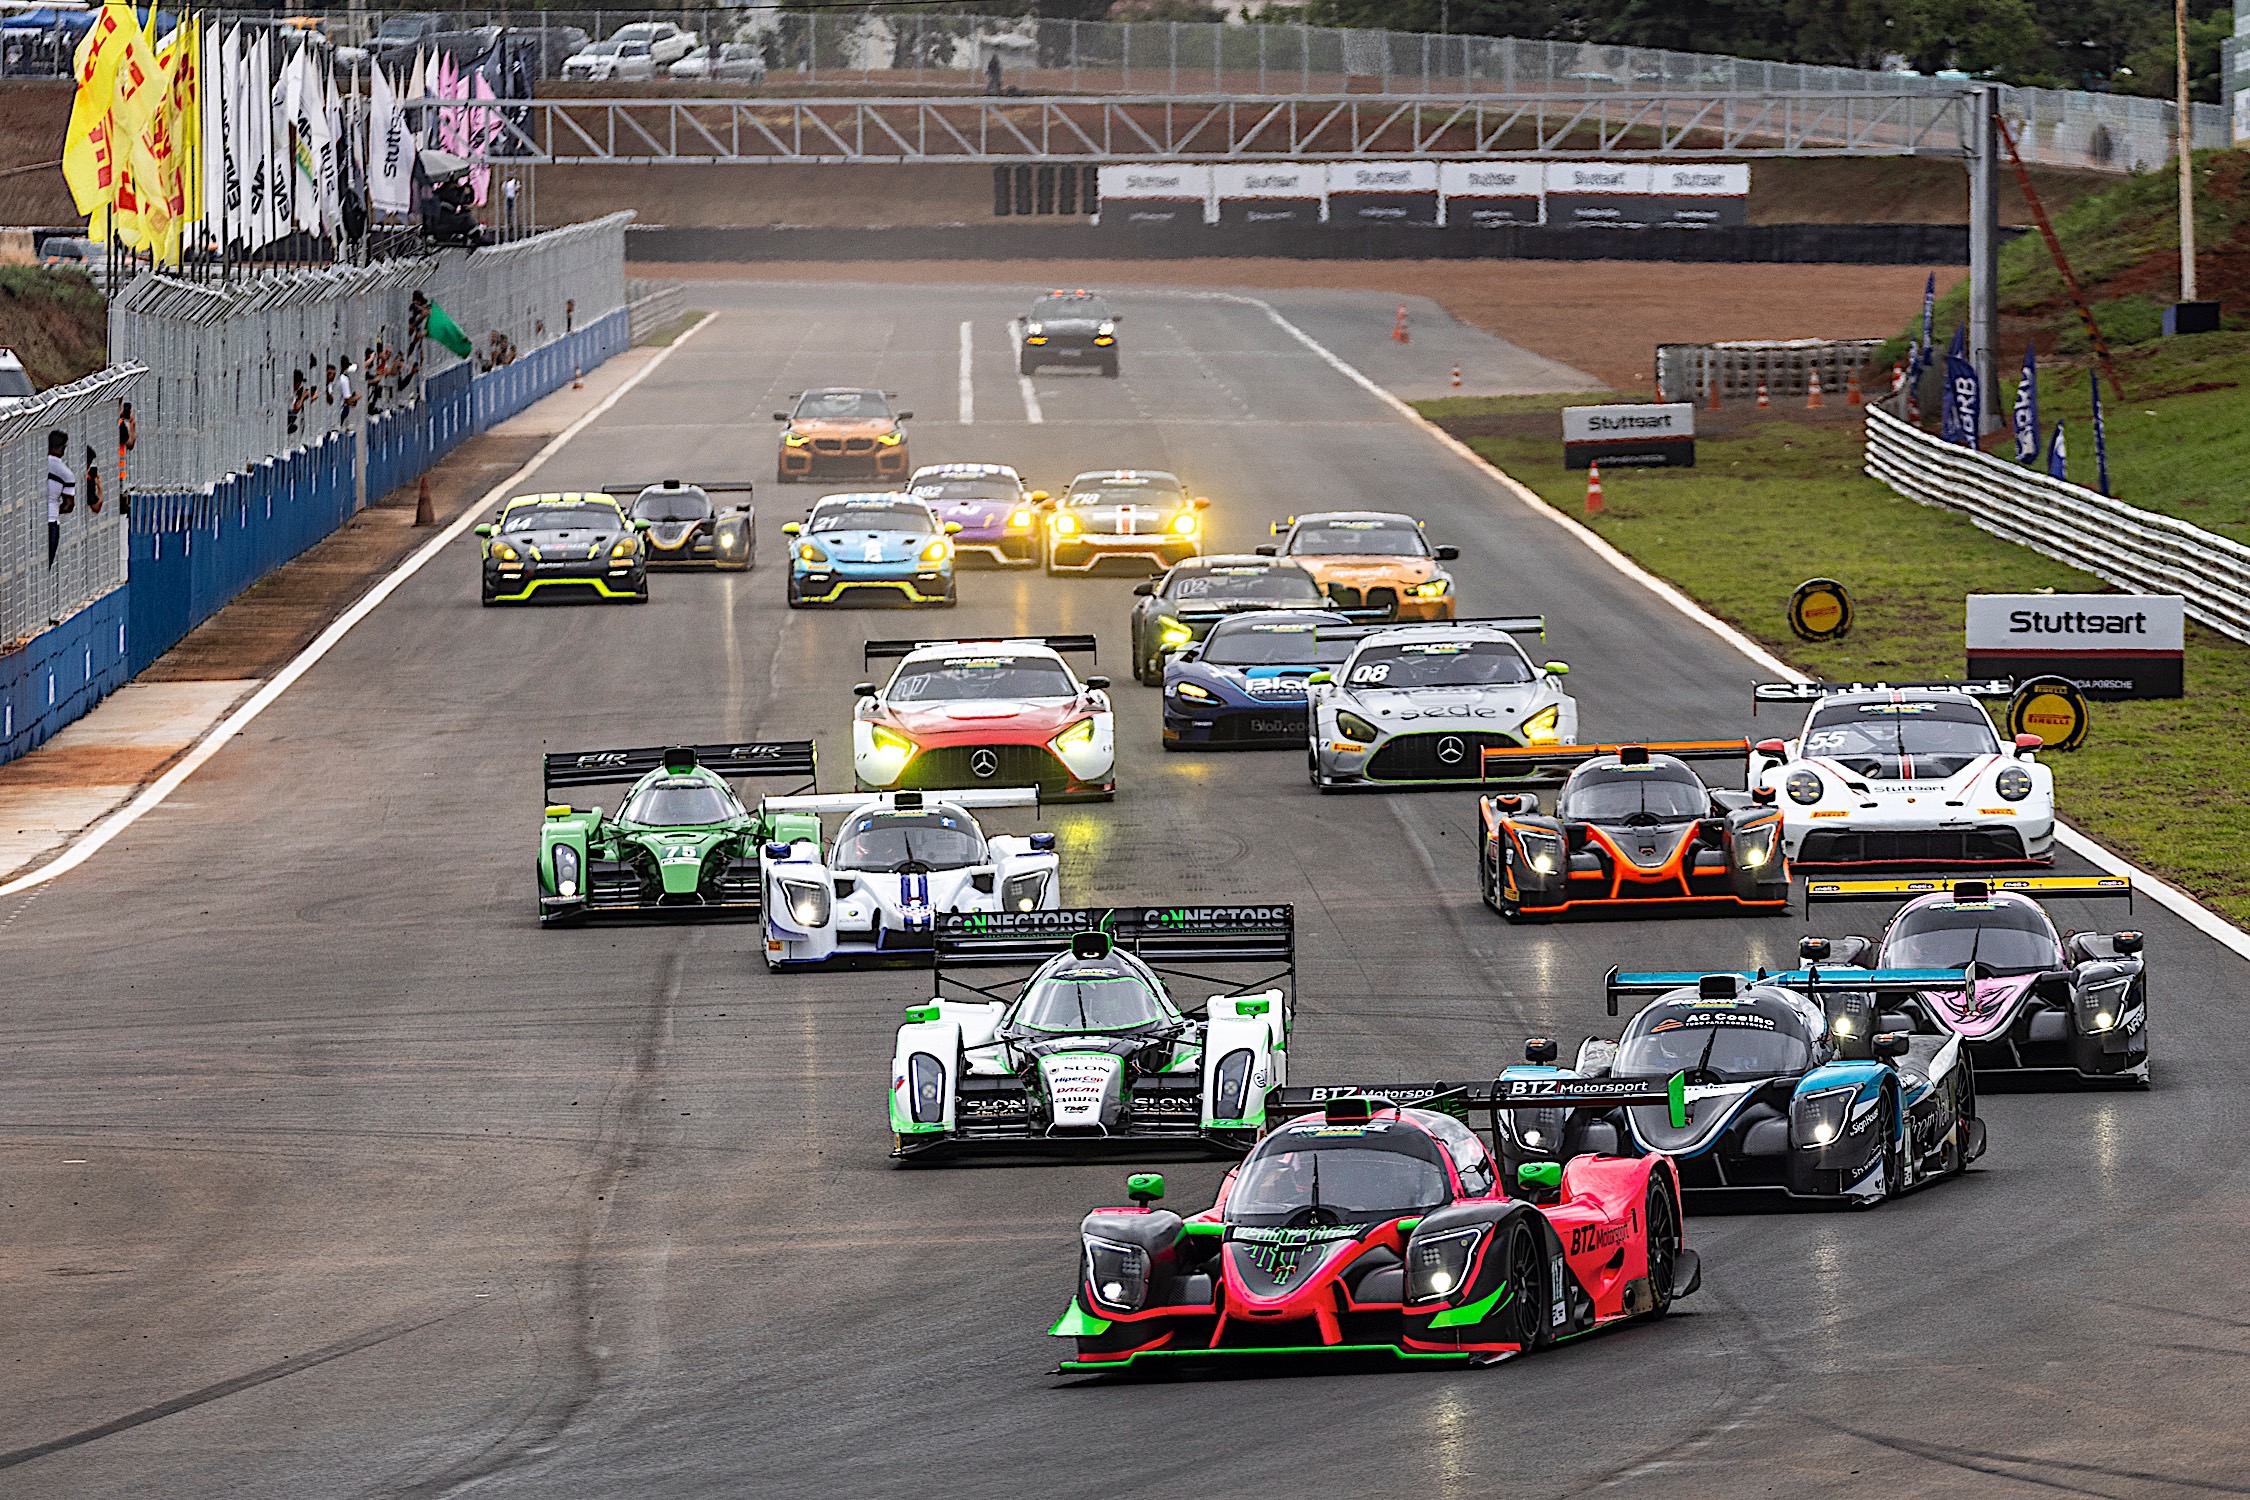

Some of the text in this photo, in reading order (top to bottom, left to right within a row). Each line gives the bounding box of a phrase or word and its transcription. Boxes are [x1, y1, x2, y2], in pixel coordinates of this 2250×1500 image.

[1588, 414, 1672, 431] Stuttgart
[2009, 611, 2147, 633] Stuttgart
[1353, 664, 1391, 682] 08
[901, 674, 931, 698] 17
[2028, 713, 2074, 725] PIRELLI
[1807, 731, 1848, 751] 55
[1874, 785, 1947, 793] Stuttgart
[665, 845, 697, 858] 75
[947, 911, 1087, 935] CONNECTORS
[1144, 907, 1285, 929] CONNECTORS
[1686, 1013, 1775, 1027] AC Coelho
[1064, 1065, 1111, 1073] SLON
[1311, 1086, 1434, 1101] BTZ Motorspo
[1511, 1081, 1649, 1095] BTZ Motorsport
[1133, 1097, 1193, 1111] SLON
[1288, 1124, 1393, 1134] ENDURANCE
[1570, 1222, 1631, 1256] BTZ Motorsport
